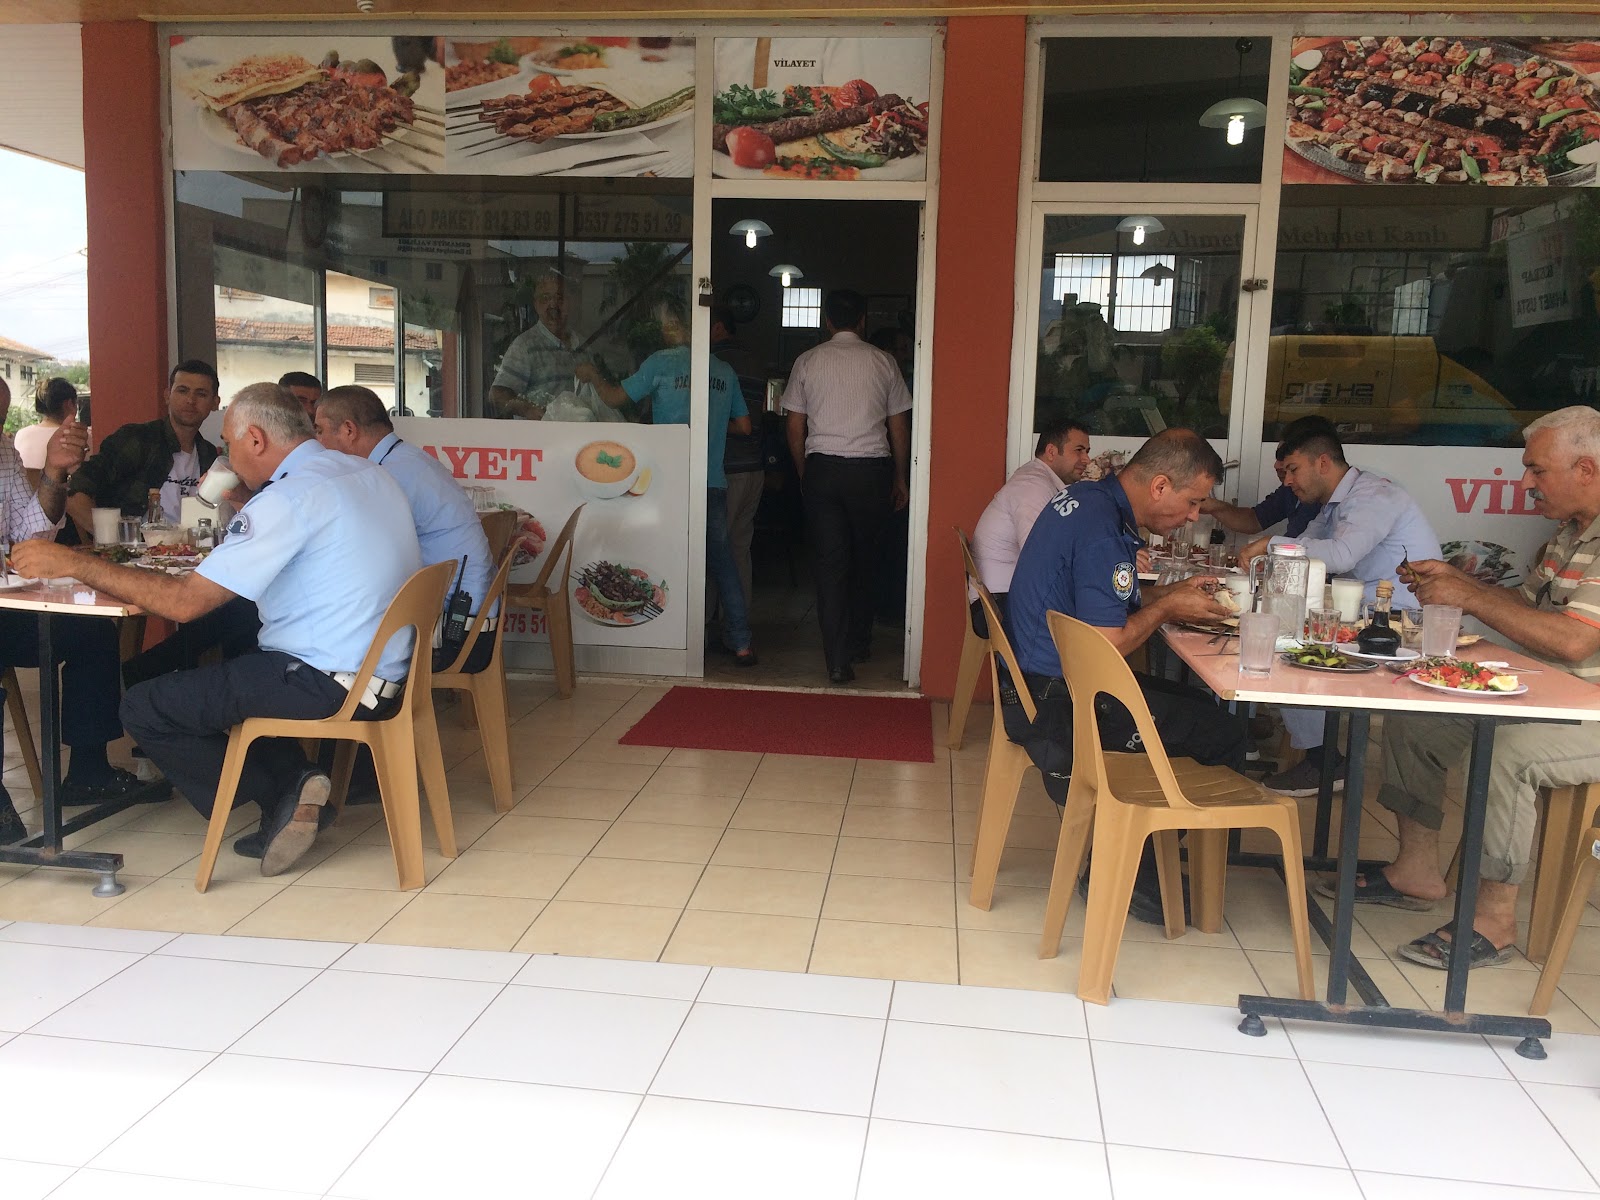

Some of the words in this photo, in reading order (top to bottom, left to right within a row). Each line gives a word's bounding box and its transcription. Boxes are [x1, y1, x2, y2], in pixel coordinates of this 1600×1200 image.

[774, 58, 816, 67] VİLAYET
[614, 211, 639, 232] 275
[1445, 468, 1543, 516] VİL
[531, 614, 546, 634] 51
